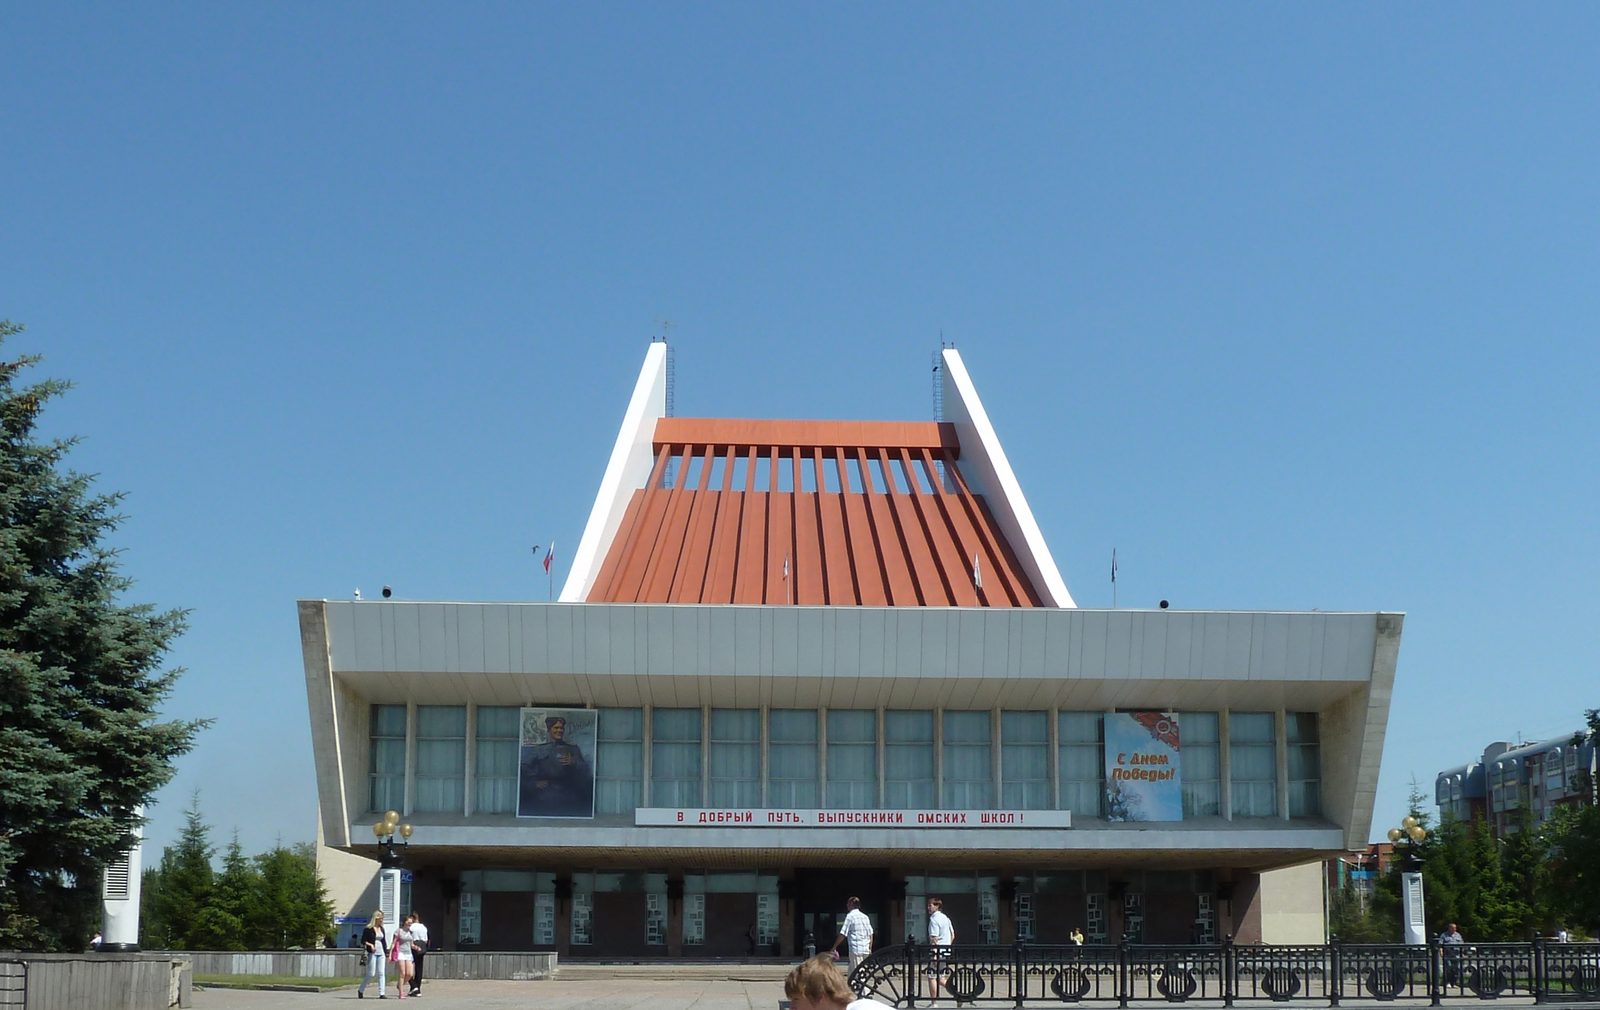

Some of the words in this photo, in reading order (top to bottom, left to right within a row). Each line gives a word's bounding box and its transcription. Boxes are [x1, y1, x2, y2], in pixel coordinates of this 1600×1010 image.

[1118, 752, 1126, 765] С
[1112, 768, 1175, 782] Победы!
[677, 812, 685, 822] В
[698, 811, 753, 824] ДОБРЫЙ
[818, 813, 904, 823] ВЫПУСКНИКИ
[917, 813, 967, 824] ОМСКИХ
